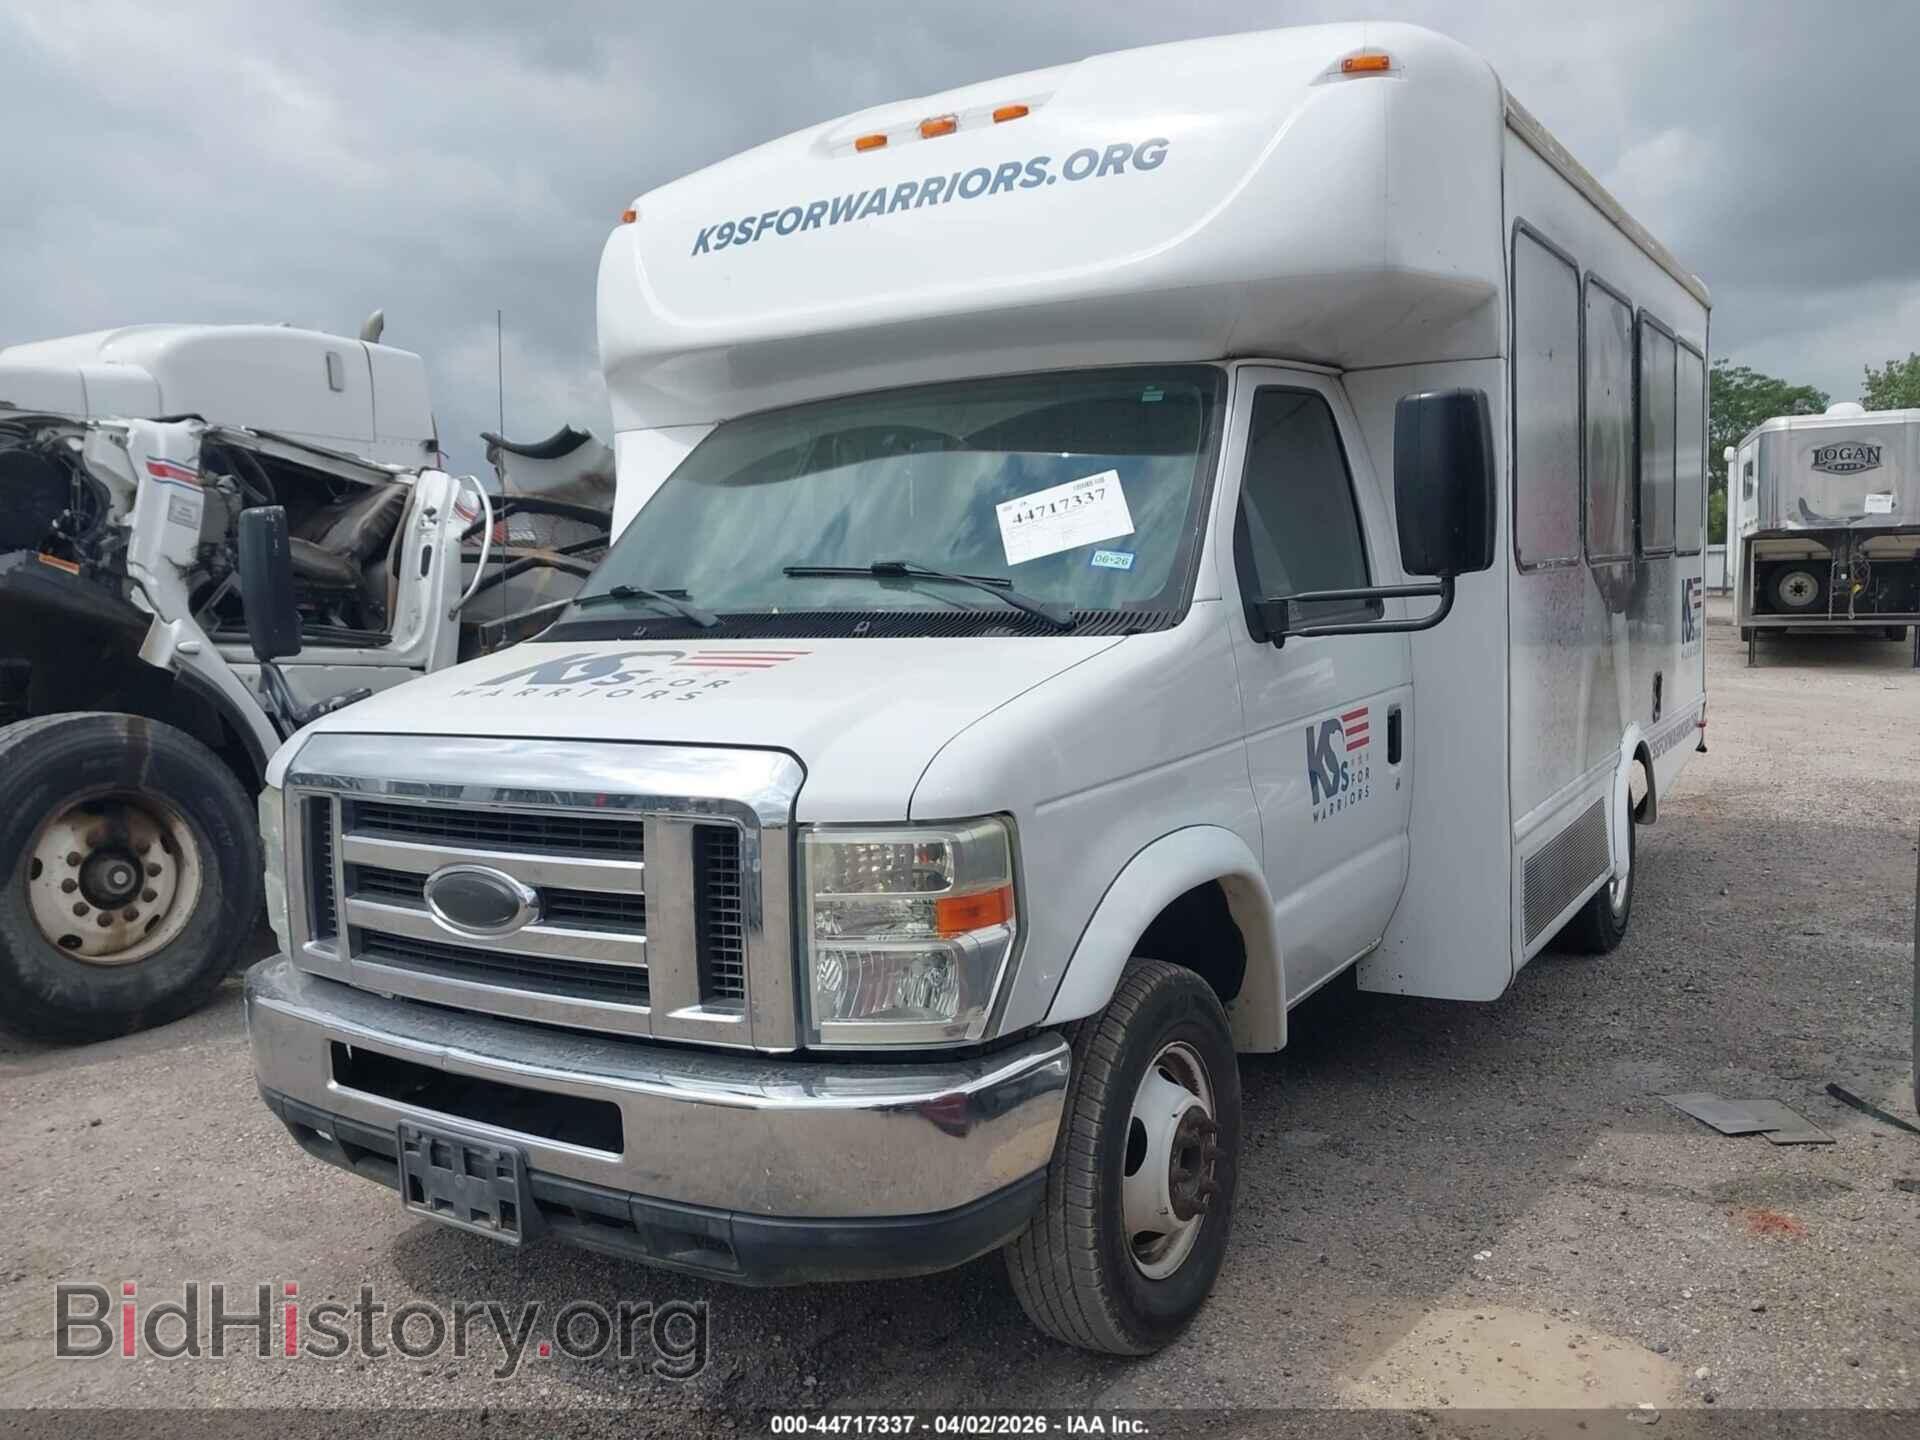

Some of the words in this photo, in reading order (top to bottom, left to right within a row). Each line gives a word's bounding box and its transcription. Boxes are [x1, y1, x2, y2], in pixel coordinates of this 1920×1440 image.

[691, 138, 1169, 256] K9SFORWARRIORS.ORG
[1811, 446, 1881, 466] LOGAN
[1012, 488, 1105, 523] 44717337
[451, 687, 703, 700] WARRIORS
[1351, 767, 1369, 786] FOR
[1313, 785, 1369, 824] WARRIORS
